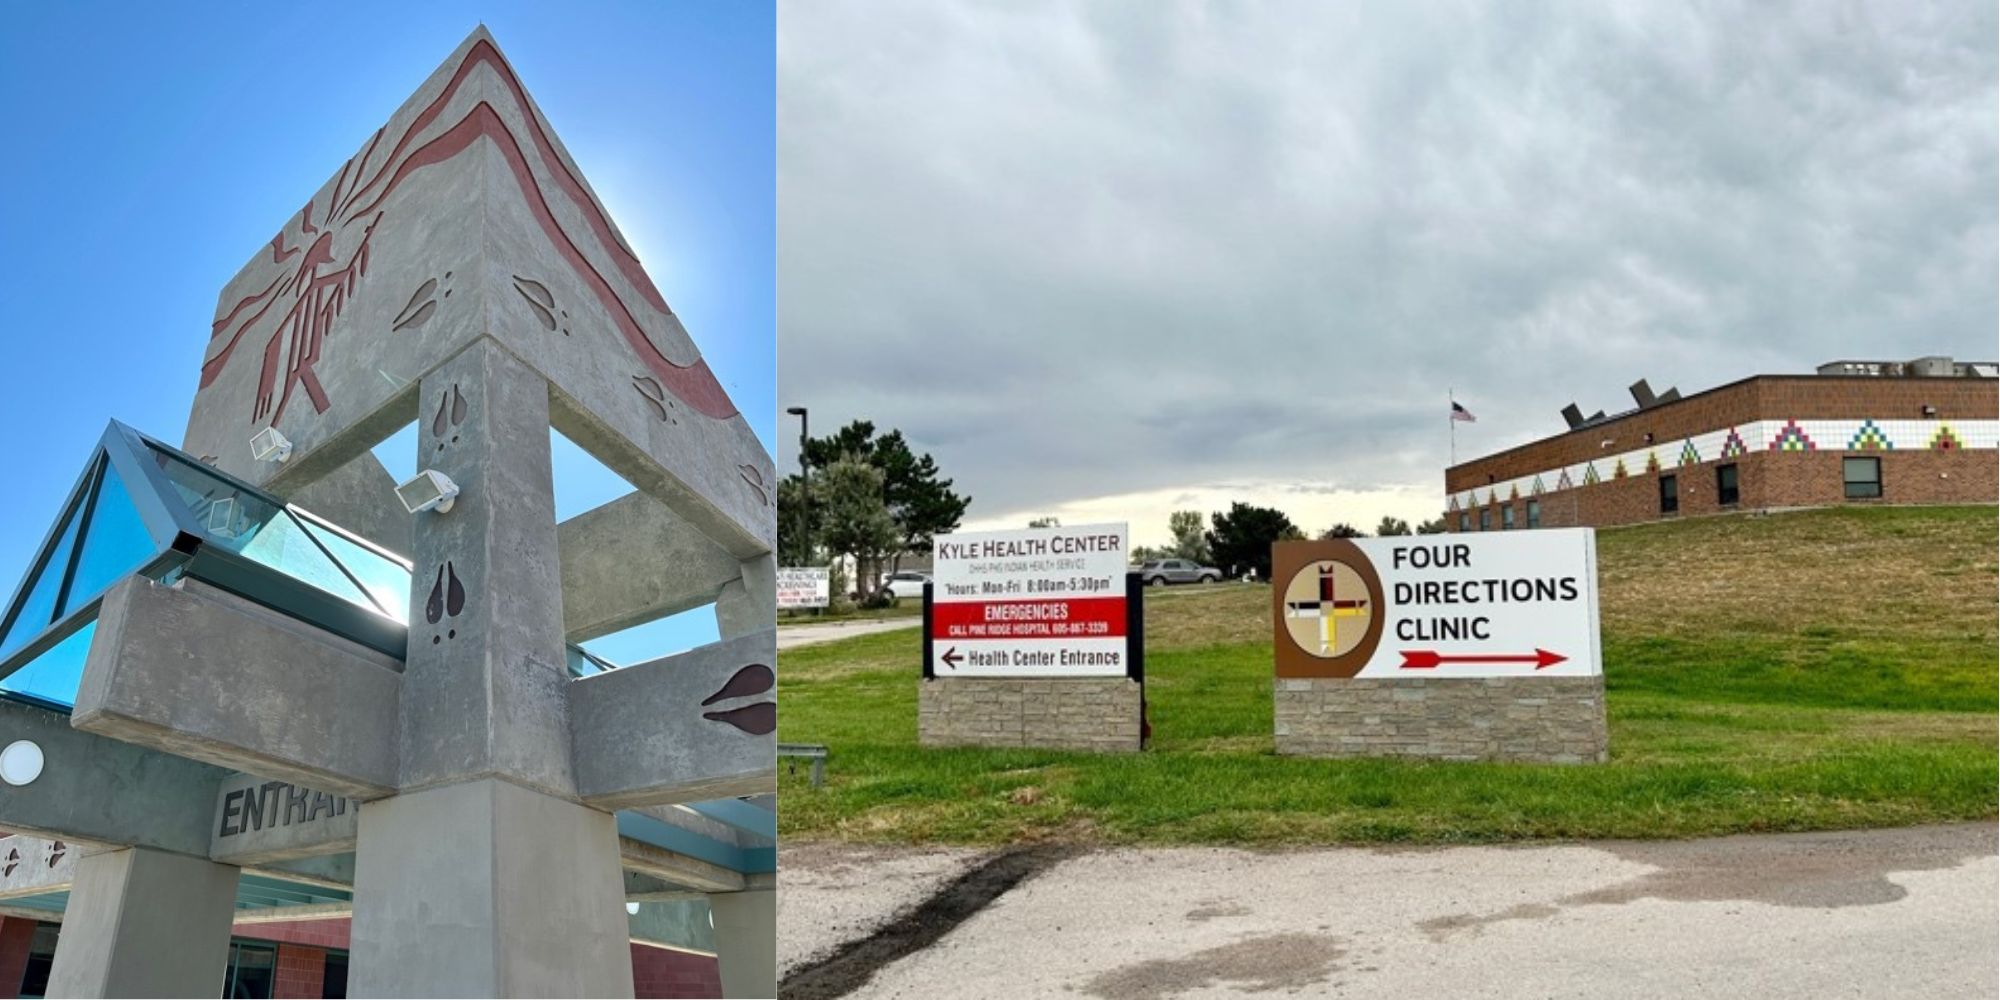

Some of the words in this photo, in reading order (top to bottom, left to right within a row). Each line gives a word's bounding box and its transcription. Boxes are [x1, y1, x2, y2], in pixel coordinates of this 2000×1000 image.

[939, 543, 979, 560] KYLE
[982, 539, 1047, 557] HEALTH
[1050, 535, 1121, 554] CENTER
[1393, 544, 1471, 569] FOUR
[1029, 560, 1055, 571] HEALTH
[1056, 558, 1086, 570] SERVICE
[982, 580, 1021, 593] Mon-Fri
[1394, 577, 1578, 605] DIRECTIONS
[985, 603, 1068, 621] EMERGENCIES
[949, 625, 967, 636] CALL
[969, 625, 986, 635] PINE
[988, 624, 1011, 635] RIDGE
[1013, 623, 1050, 635] HOSPITAL
[1396, 617, 1490, 641] CLINIC
[968, 650, 1009, 666] Health
[1013, 649, 1055, 666] Center
[1060, 648, 1120, 666] Entrance
